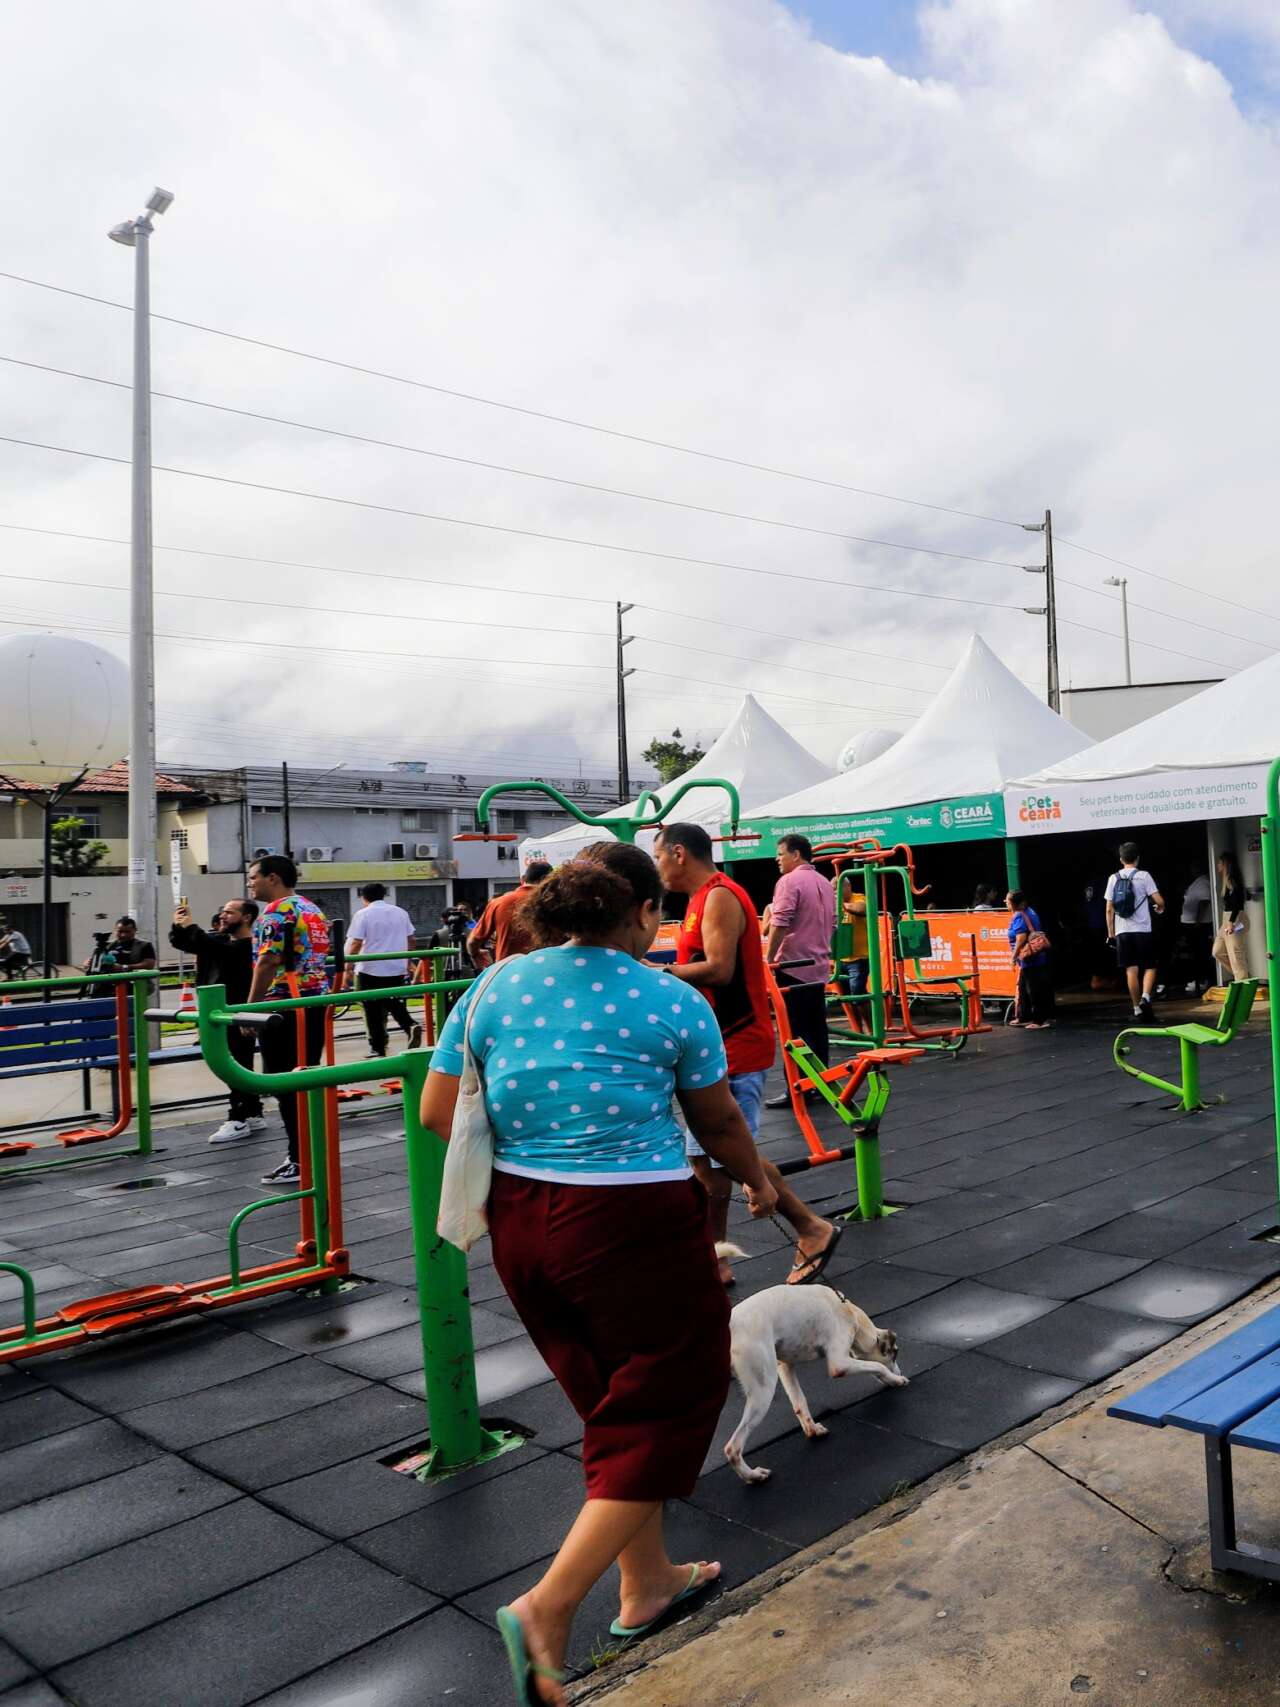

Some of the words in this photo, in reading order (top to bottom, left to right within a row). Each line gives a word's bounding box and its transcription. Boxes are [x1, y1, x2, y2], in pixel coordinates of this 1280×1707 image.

[1135, 789, 1171, 801] cuidado
[1172, 787, 1193, 797] com
[1195, 780, 1258, 795] atendimento
[954, 801, 993, 819] CEARÁ
[1027, 795, 1052, 809] Pet
[1139, 804, 1150, 814] de
[1152, 800, 1197, 814] qualidade
[1198, 801, 1205, 809] e
